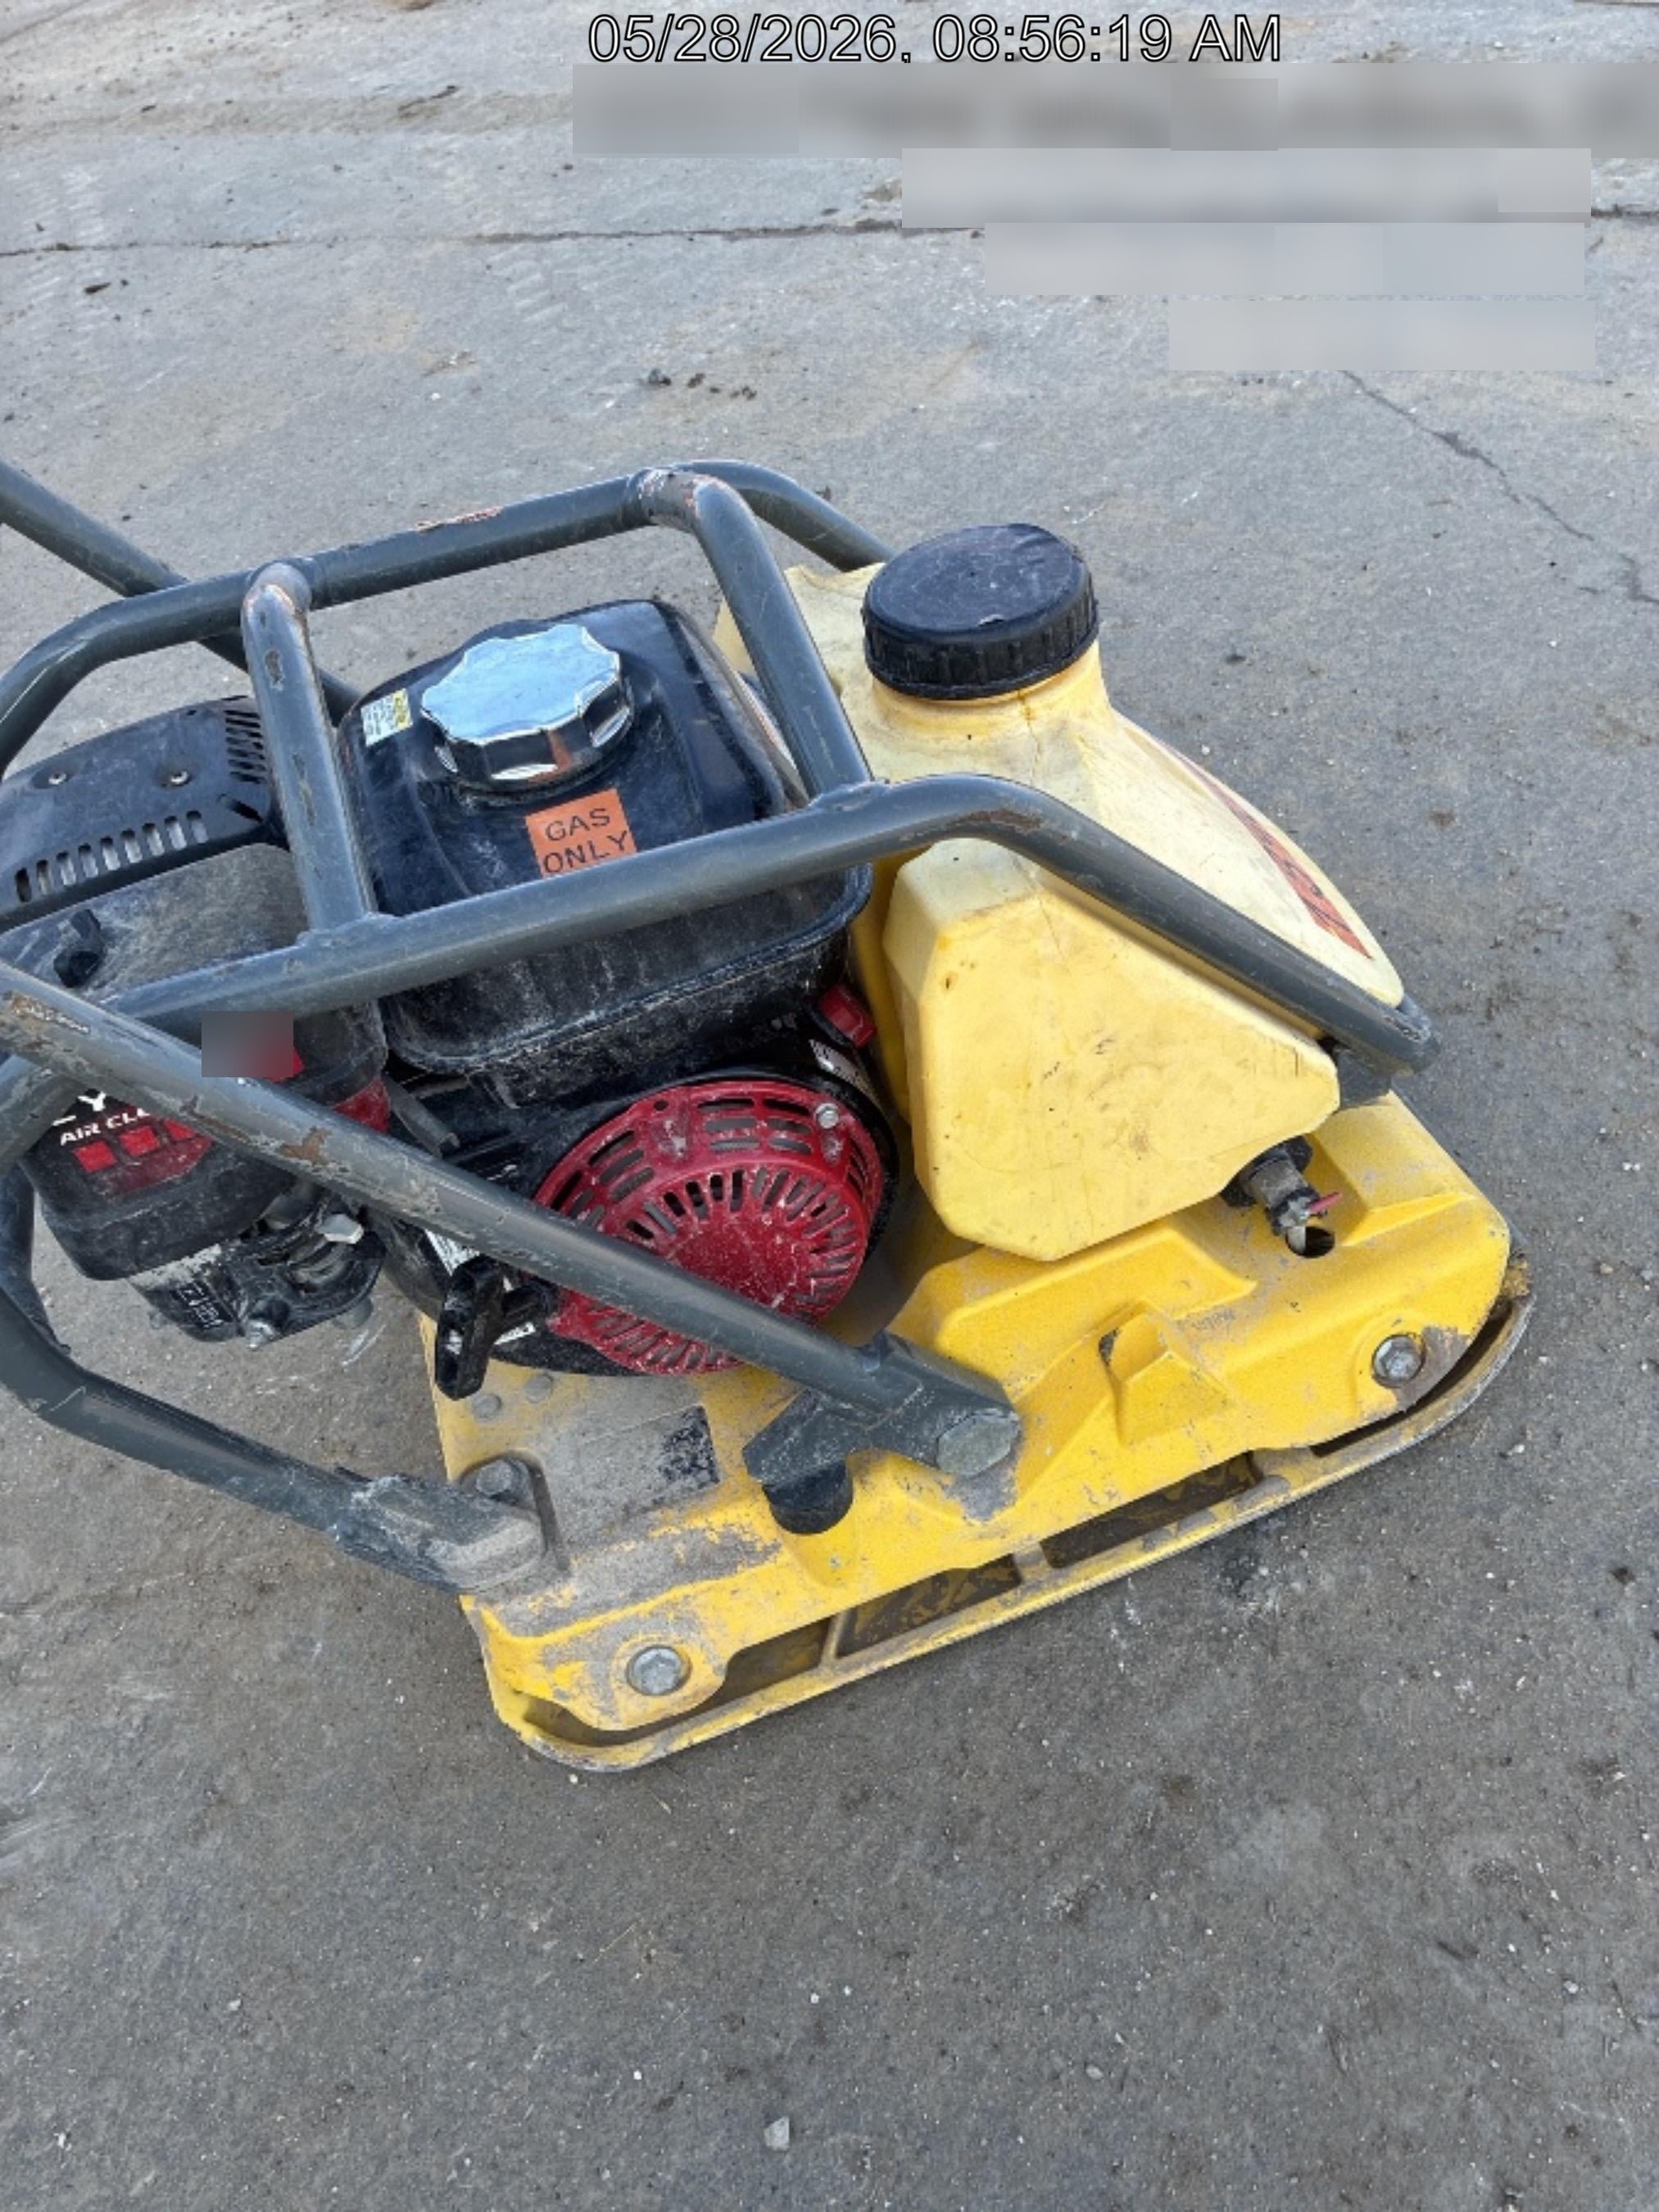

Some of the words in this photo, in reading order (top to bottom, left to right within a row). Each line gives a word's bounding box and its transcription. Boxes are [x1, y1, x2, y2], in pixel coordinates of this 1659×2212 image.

[545, 807, 610, 841] GAS
[543, 829, 628, 873] ONLY
[61, 1122, 102, 1147] AIR
